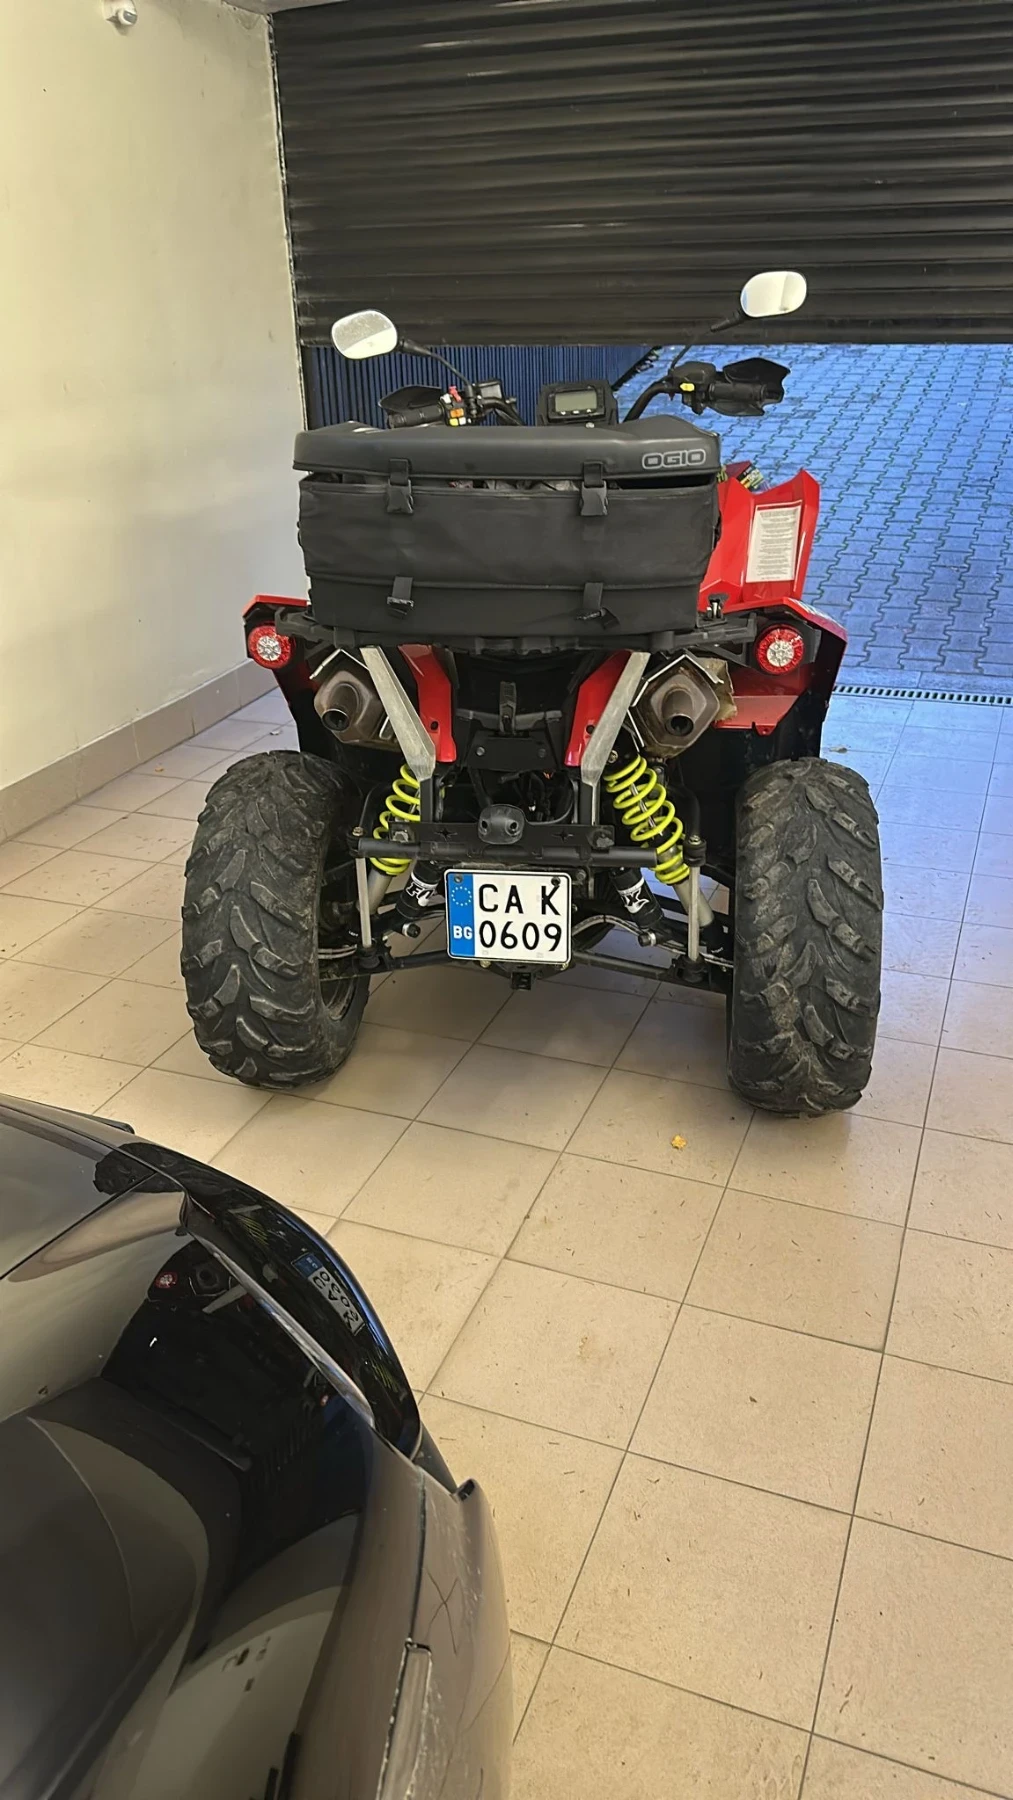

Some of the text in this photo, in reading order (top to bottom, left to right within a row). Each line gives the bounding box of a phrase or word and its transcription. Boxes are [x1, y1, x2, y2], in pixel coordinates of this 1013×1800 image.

[642, 449, 706, 469] OGIO
[479, 884, 561, 916] CA K
[453, 925, 473, 940] BG
[479, 920, 562, 952] 0609
